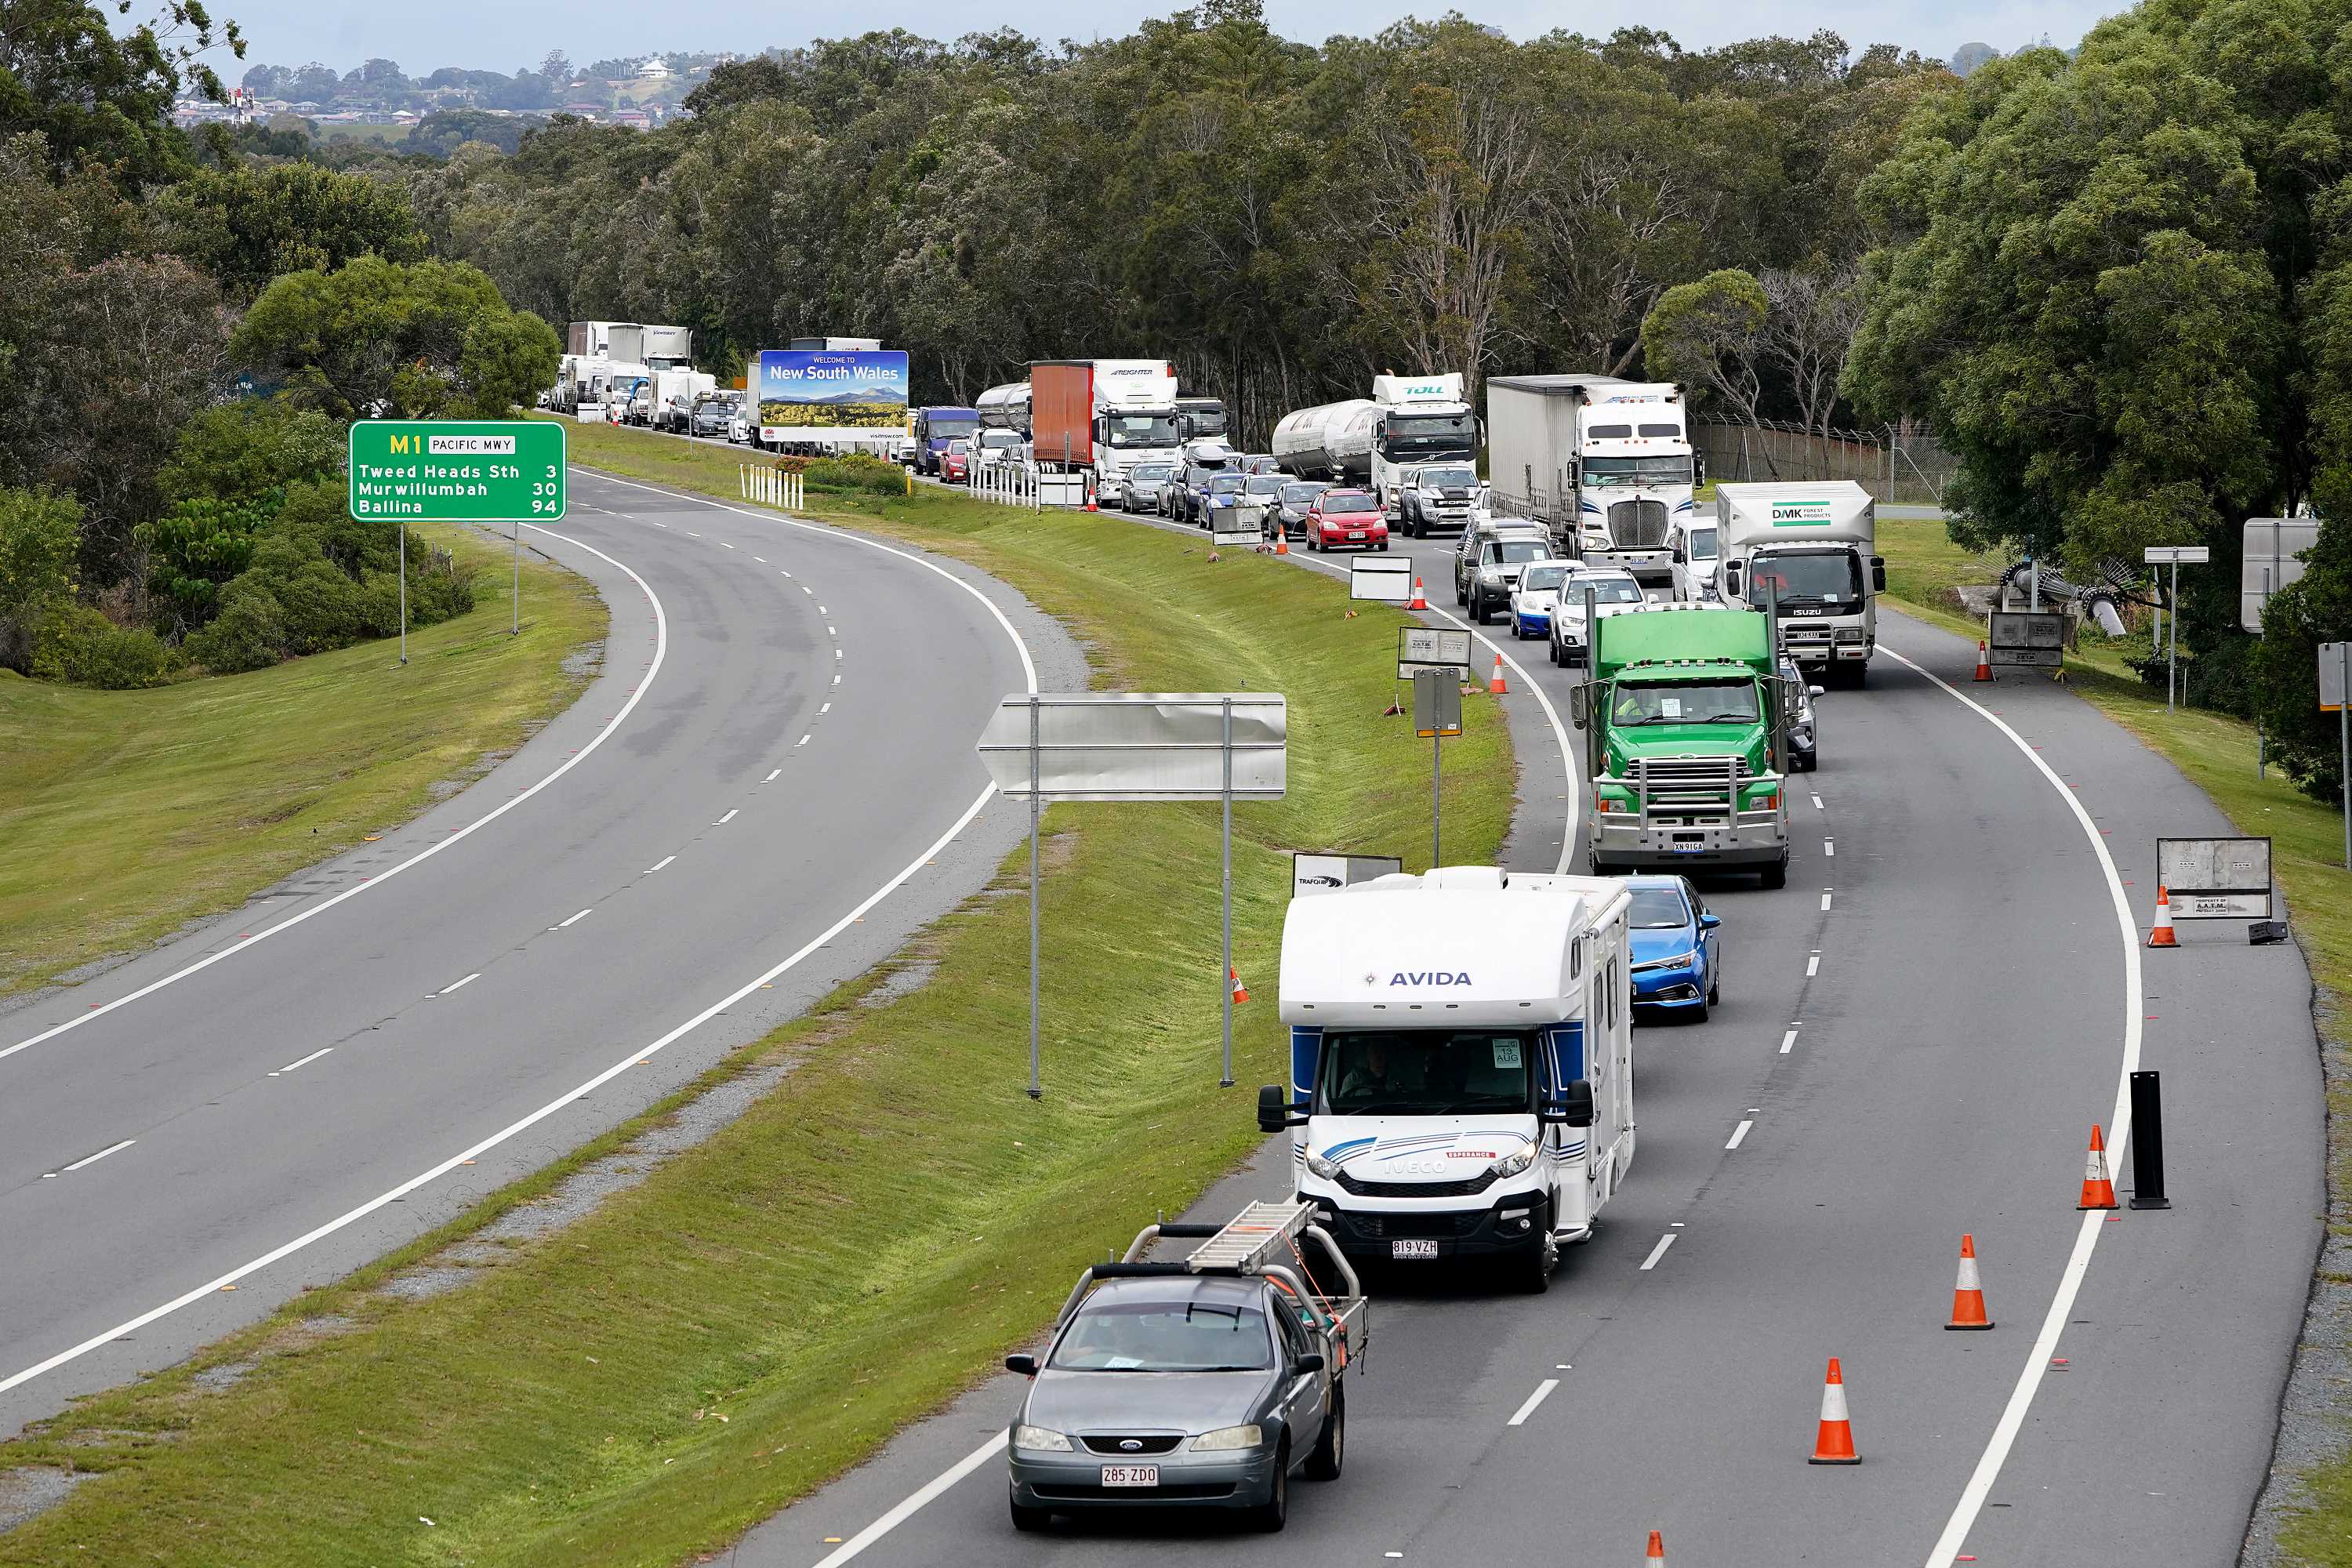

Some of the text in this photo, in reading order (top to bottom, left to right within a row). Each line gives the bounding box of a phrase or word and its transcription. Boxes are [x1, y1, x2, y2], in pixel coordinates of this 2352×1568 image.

[771, 365, 898, 380] New South Wales
[390, 435, 420, 454] M1
[433, 440, 510, 450] PACIFIC MWY
[358, 464, 557, 478] Tweed Heads Sth 3
[358, 482, 557, 495] Murwillumbah 30
[358, 499, 557, 514] Ballina 94
[1773, 509, 1802, 518] DMK
[1389, 971, 1472, 986] AVIDA
[1384, 1160, 1447, 1174] IVECO
